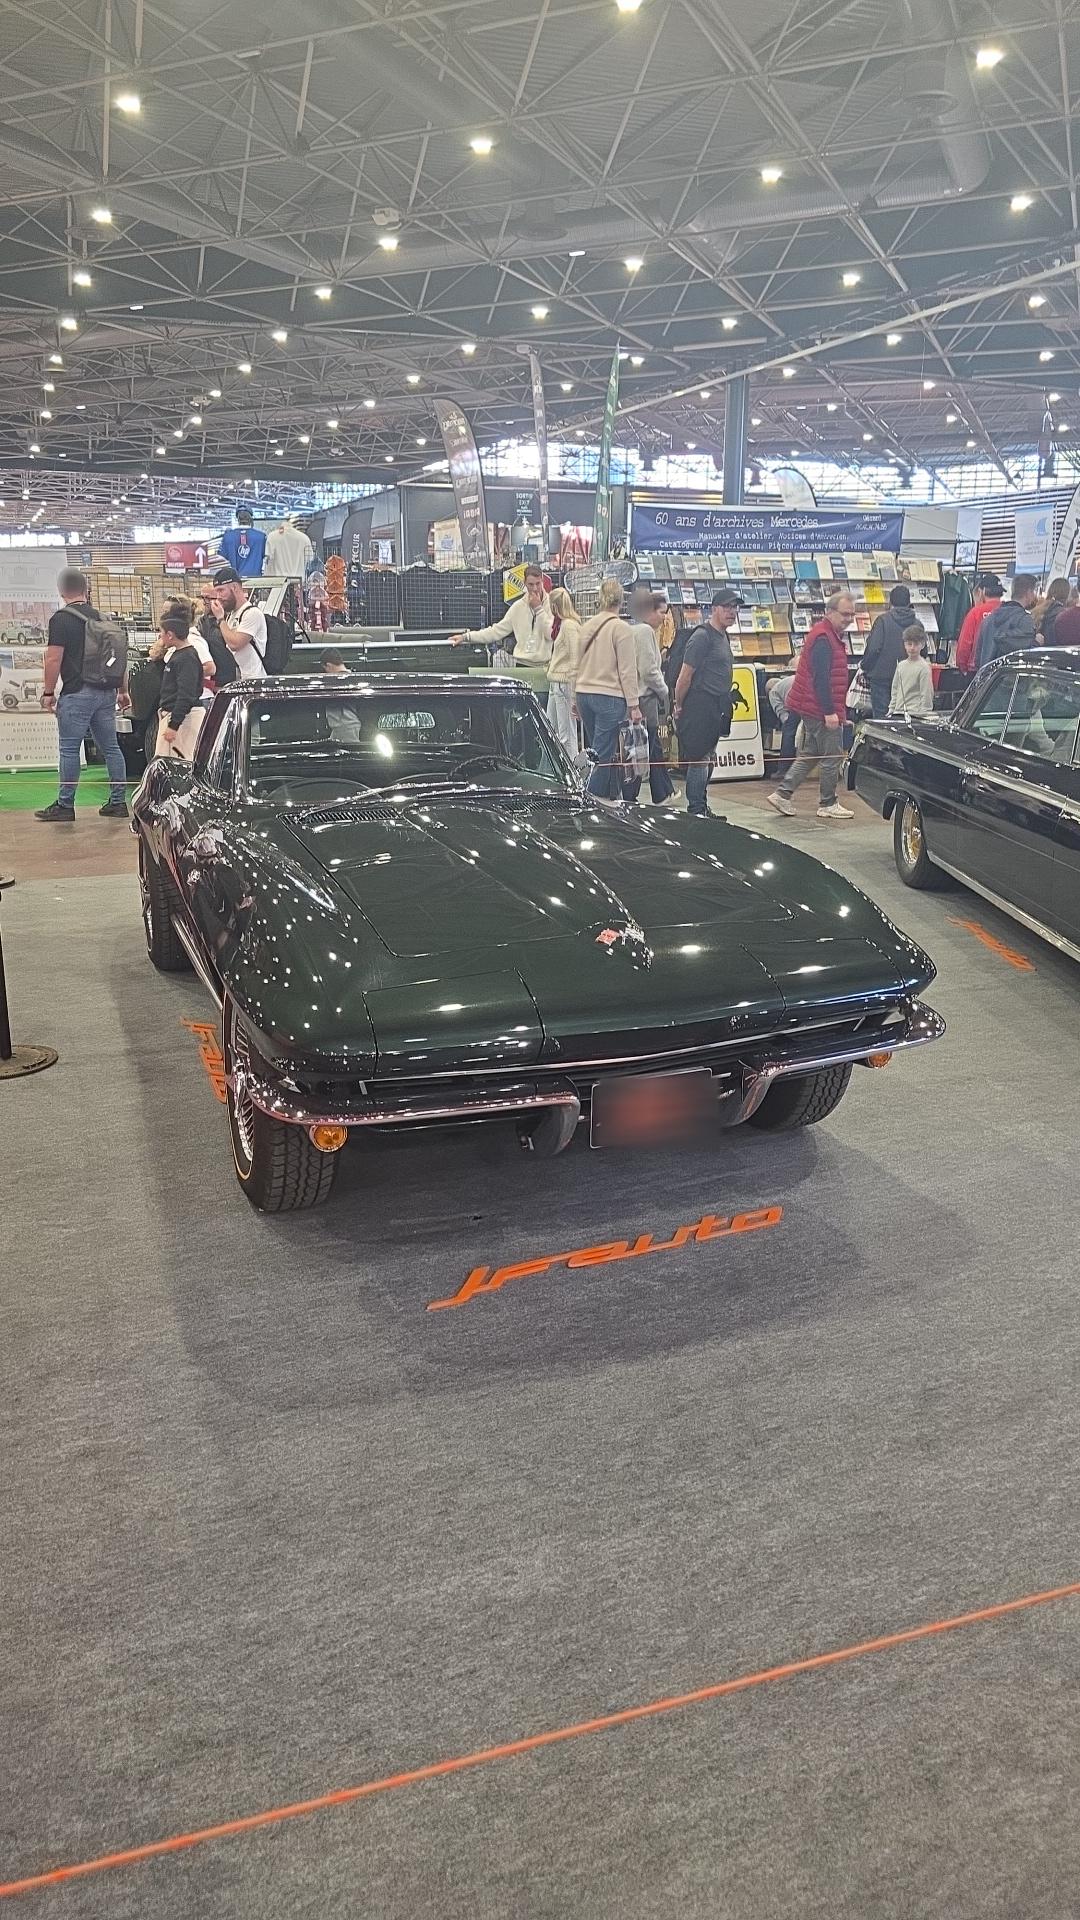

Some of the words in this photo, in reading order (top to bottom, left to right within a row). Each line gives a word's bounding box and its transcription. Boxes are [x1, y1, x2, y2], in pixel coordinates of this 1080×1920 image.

[655, 512, 669, 525] 60
[675, 516, 697, 528] ans
[702, 512, 764, 528] d'archives
[770, 515, 819, 528] Mercedes
[698, 532, 730, 540] Manuels
[659, 541, 703, 549] Catalogues
